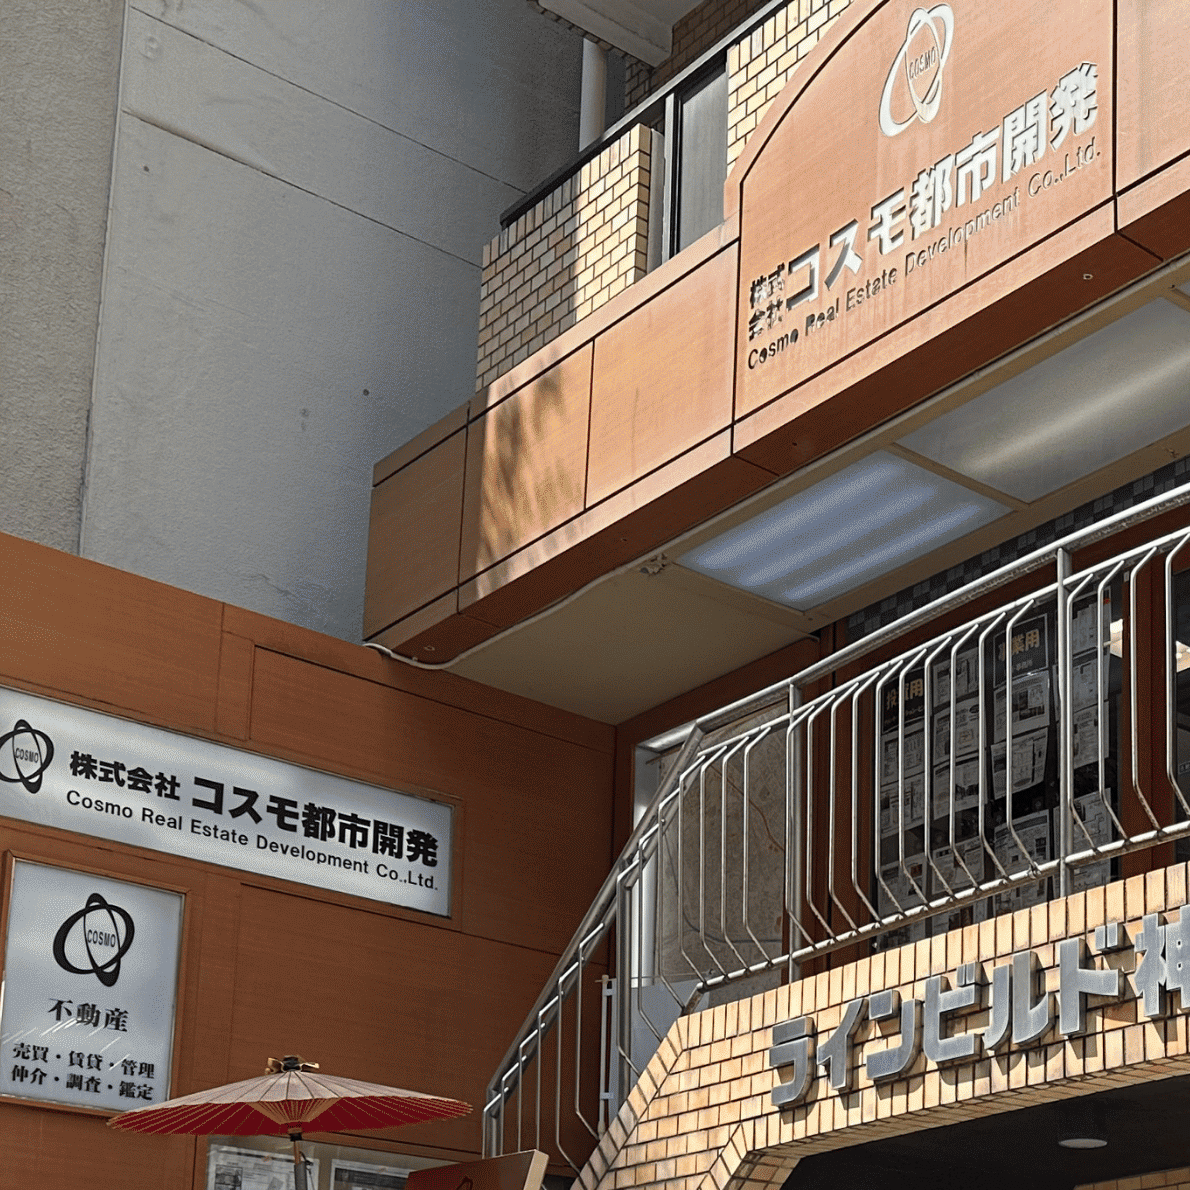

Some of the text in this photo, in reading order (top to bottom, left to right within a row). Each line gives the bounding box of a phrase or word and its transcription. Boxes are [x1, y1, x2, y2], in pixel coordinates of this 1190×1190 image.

[909, 46, 938, 79] COSMO
[786, 61, 1099, 311] コスモ都市開発
[747, 137, 1102, 370] Cosmo Real Estate Development Co.,Ltd.
[15, 746, 40, 765] COSMO
[66, 789, 439, 891] Cosmo Real Estate Development Co.,Ltd.
[69, 750, 439, 868] 株式会社 コスモ都市開発
[86, 928, 117, 949] COSMO
[47, 997, 129, 1033] 不動産
